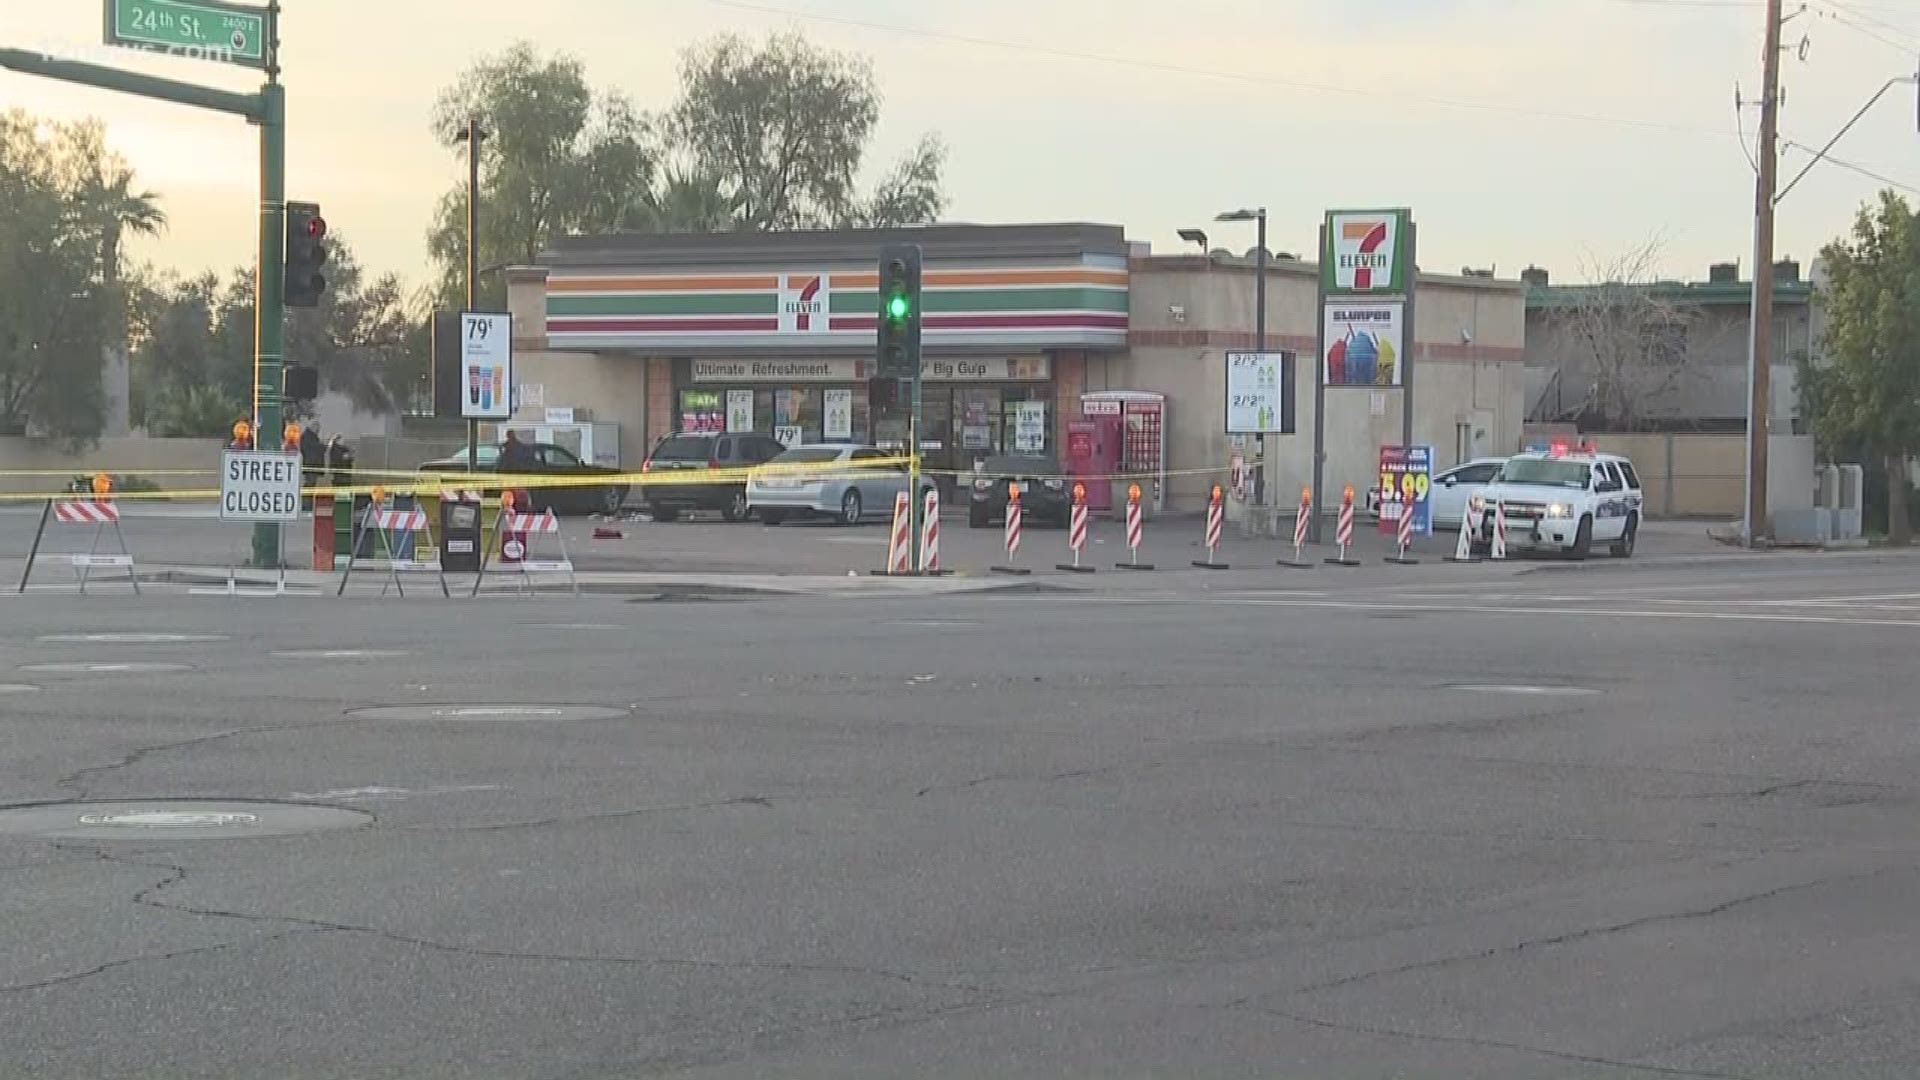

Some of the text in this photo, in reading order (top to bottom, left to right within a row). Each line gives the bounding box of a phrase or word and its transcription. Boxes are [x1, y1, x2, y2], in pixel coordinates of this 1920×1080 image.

[131, 6, 207, 40] 24th St.
[1342, 222, 1386, 288] 7
[787, 275, 820, 330] 7
[695, 362, 745, 375] Ultimate
[933, 361, 954, 377] Big
[697, 394, 719, 406] ATM
[229, 460, 295, 481] STREET
[226, 491, 295, 512] CLOSED
